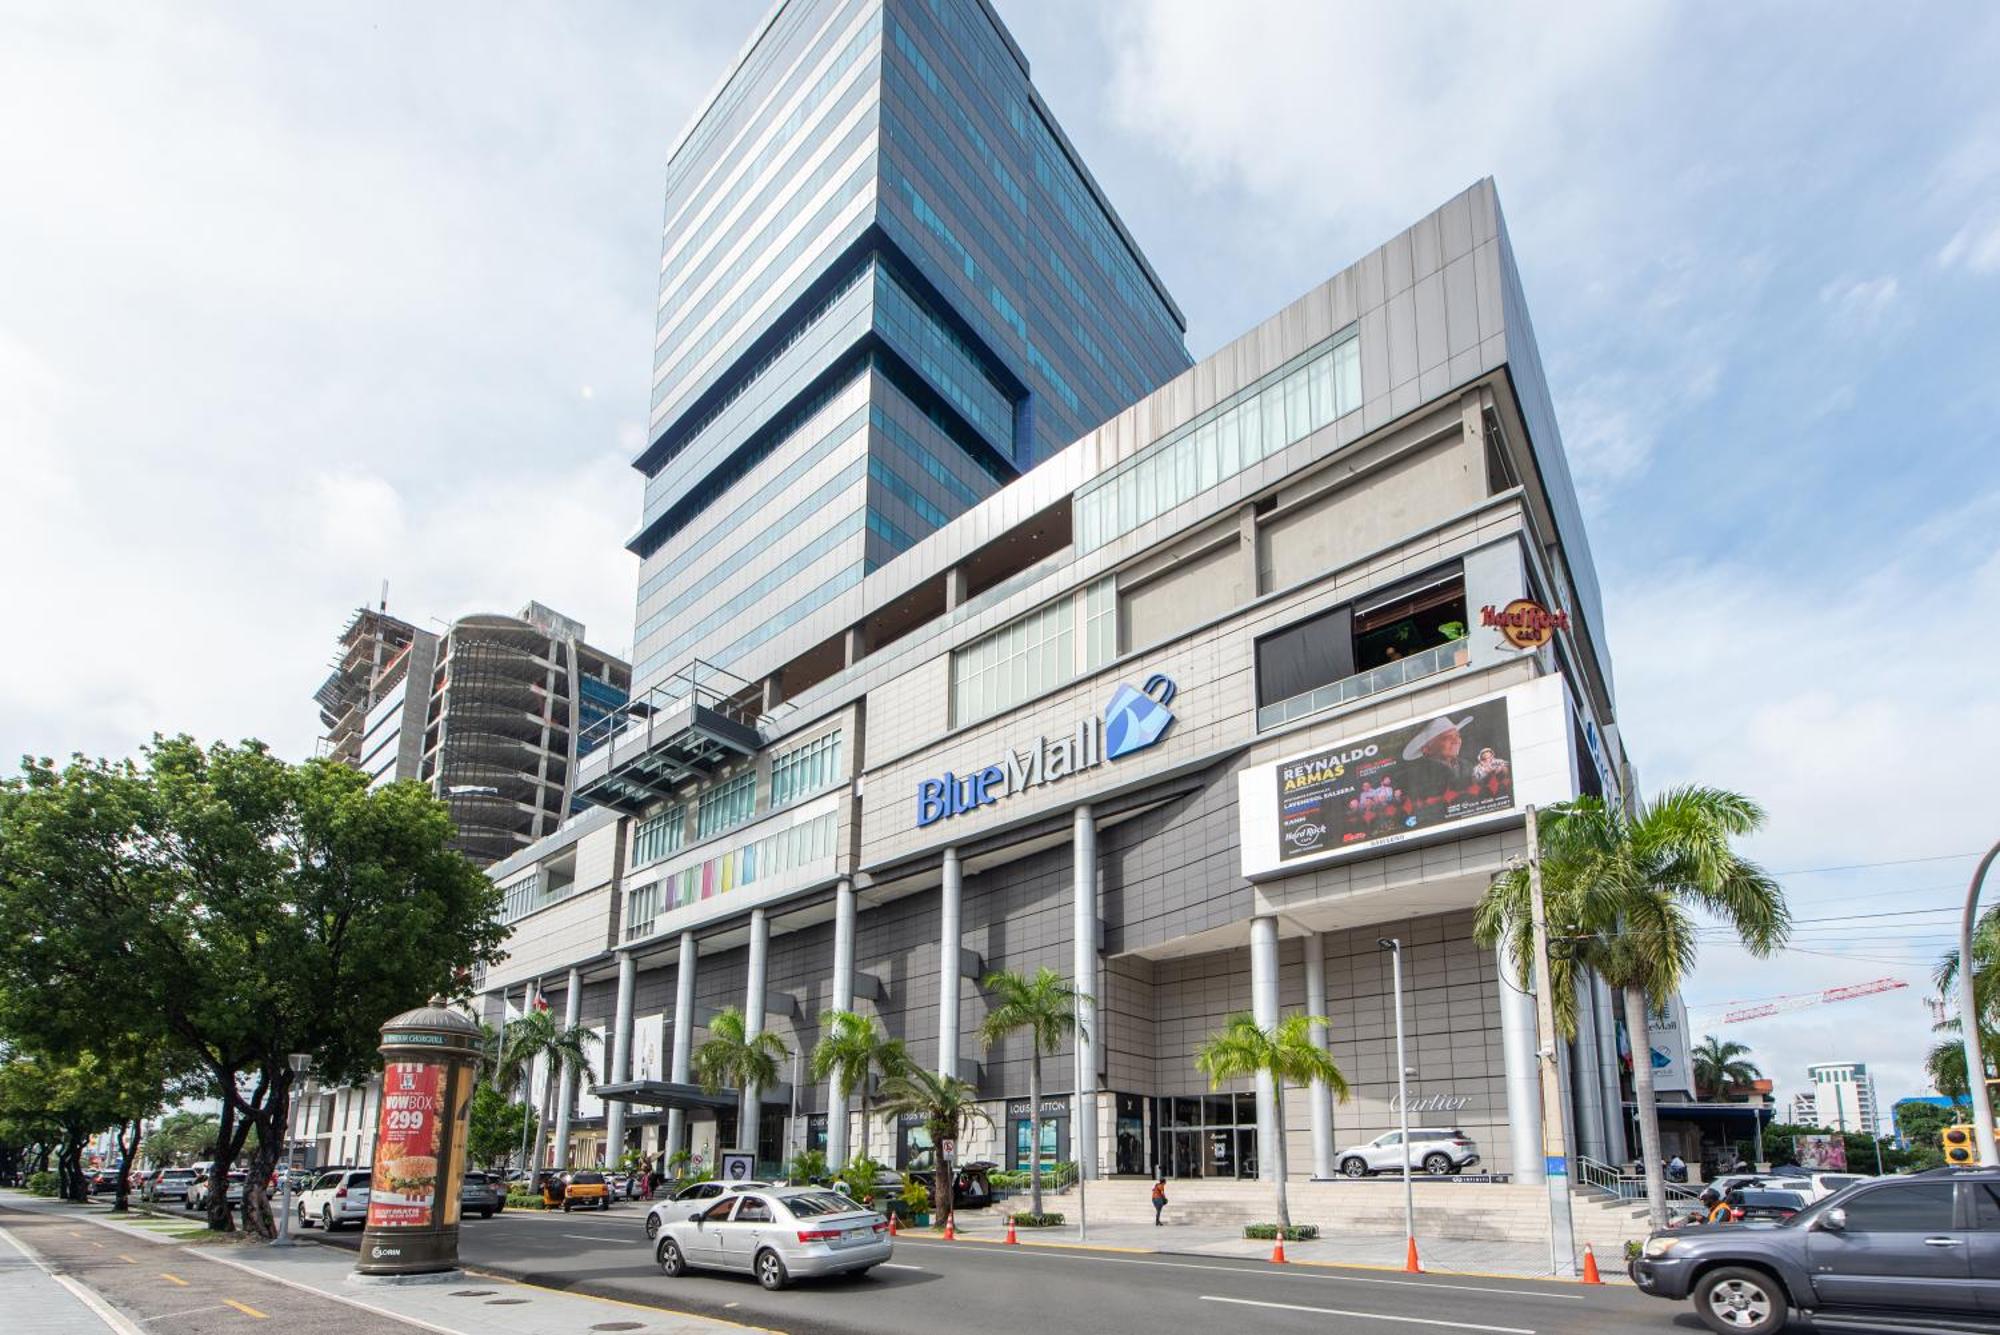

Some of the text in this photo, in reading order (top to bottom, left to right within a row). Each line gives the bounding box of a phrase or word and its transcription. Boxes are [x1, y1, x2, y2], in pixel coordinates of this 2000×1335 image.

[916, 714, 1101, 828] BlueMall
[1283, 744, 1379, 781] REYNALDO
[1284, 764, 1345, 791] ARMAS
